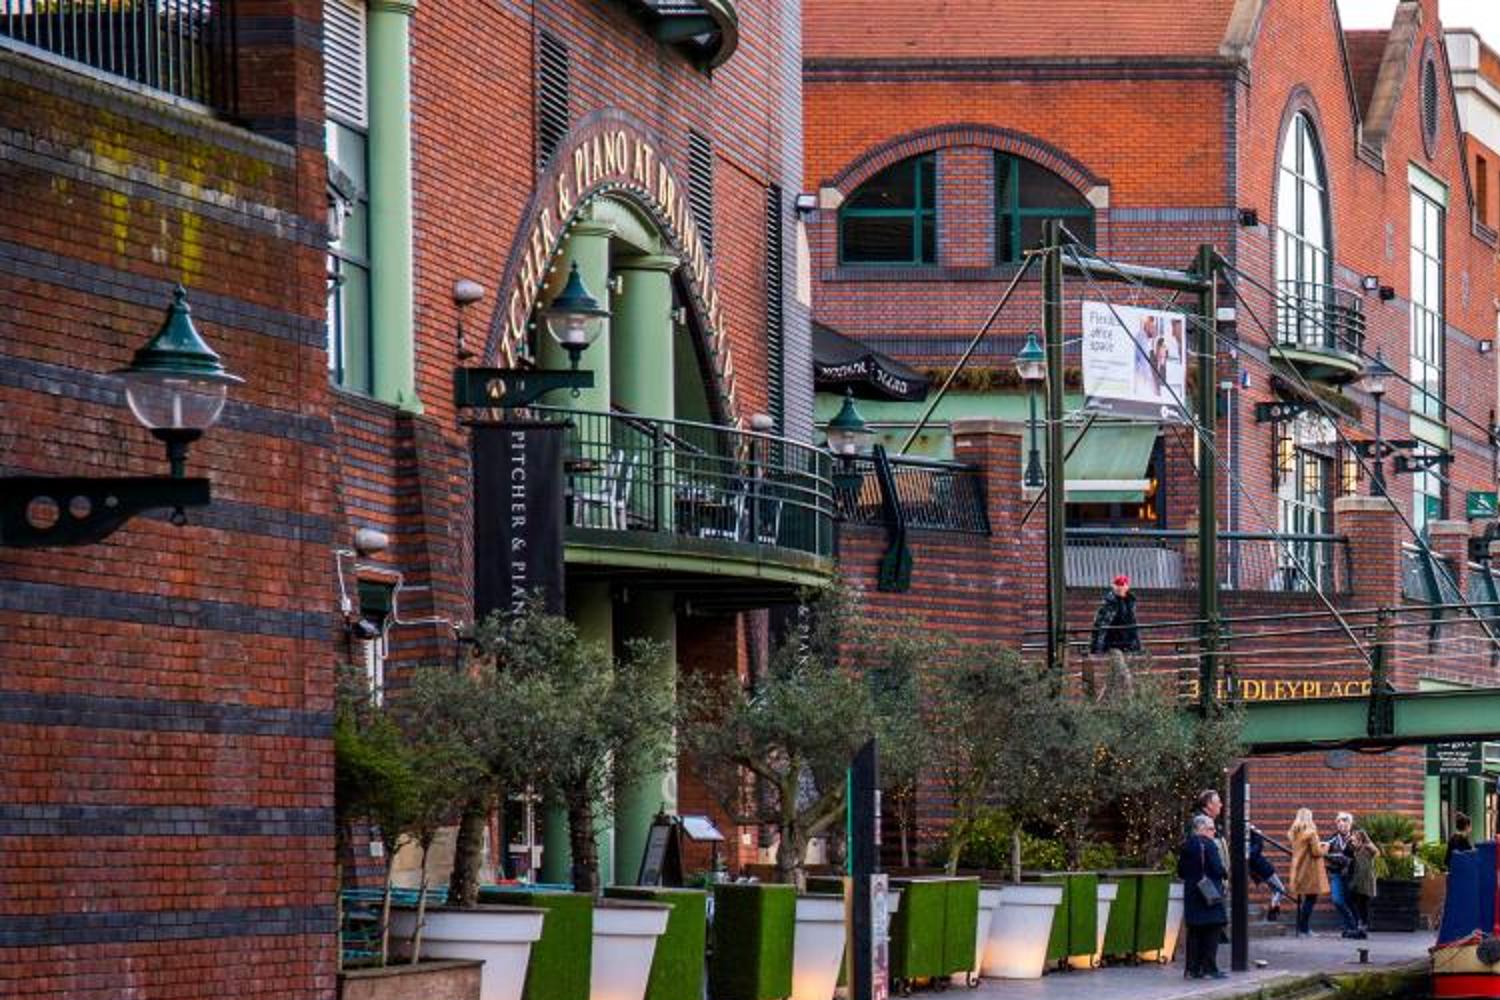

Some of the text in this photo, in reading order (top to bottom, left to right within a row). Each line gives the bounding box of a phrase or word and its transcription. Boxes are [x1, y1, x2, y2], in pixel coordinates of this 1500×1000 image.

[557, 173, 573, 220] &
[574, 130, 629, 196] PIANO
[632, 144, 654, 188] AT
[511, 431, 526, 529] PITCHER
[511, 537, 526, 552] &
